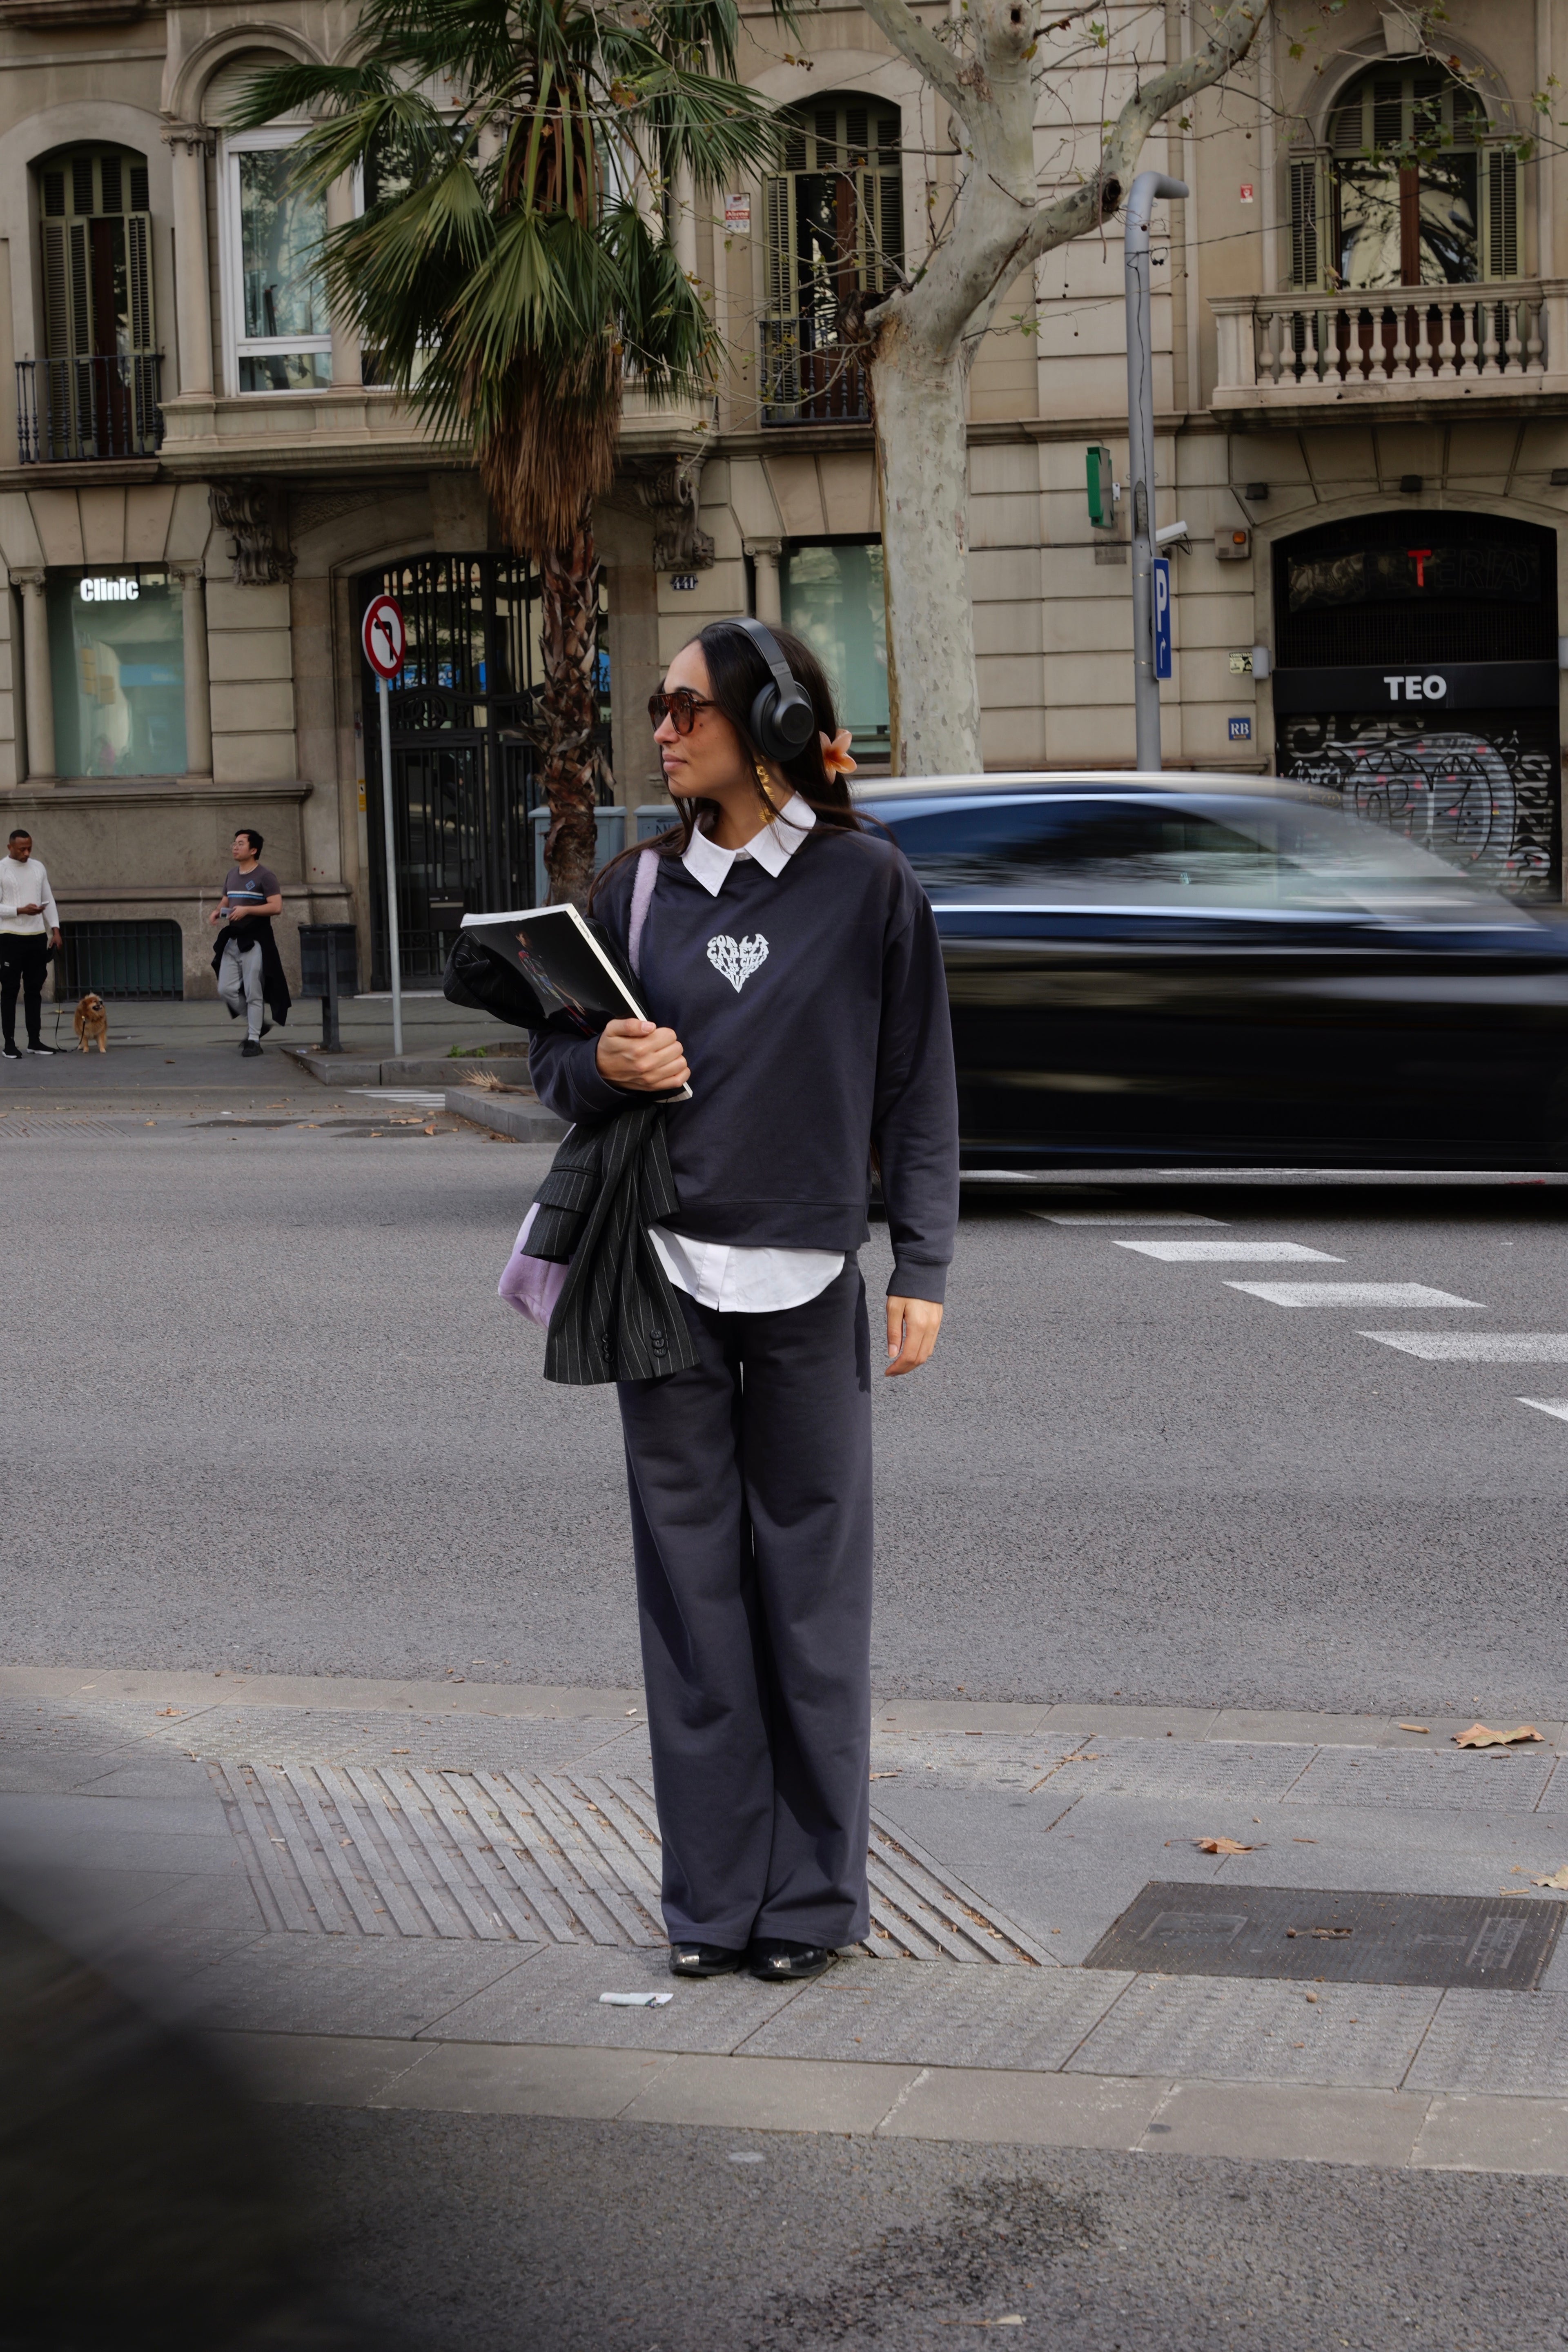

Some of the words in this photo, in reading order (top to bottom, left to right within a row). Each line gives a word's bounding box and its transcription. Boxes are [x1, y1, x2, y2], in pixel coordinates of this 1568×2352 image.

[80, 578, 140, 602] Clinic
[673, 577, 694, 589] 441
[1156, 568, 1167, 633] P
[1384, 675, 1447, 701] TEO
[1231, 722, 1249, 735] RB
[707, 934, 738, 949] CON
[739, 933, 769, 949] LA
[706, 945, 769, 960] CABEZA
[710, 958, 726, 969] EN
[727, 958, 738, 968] EL
[740, 954, 767, 968] CIELO
